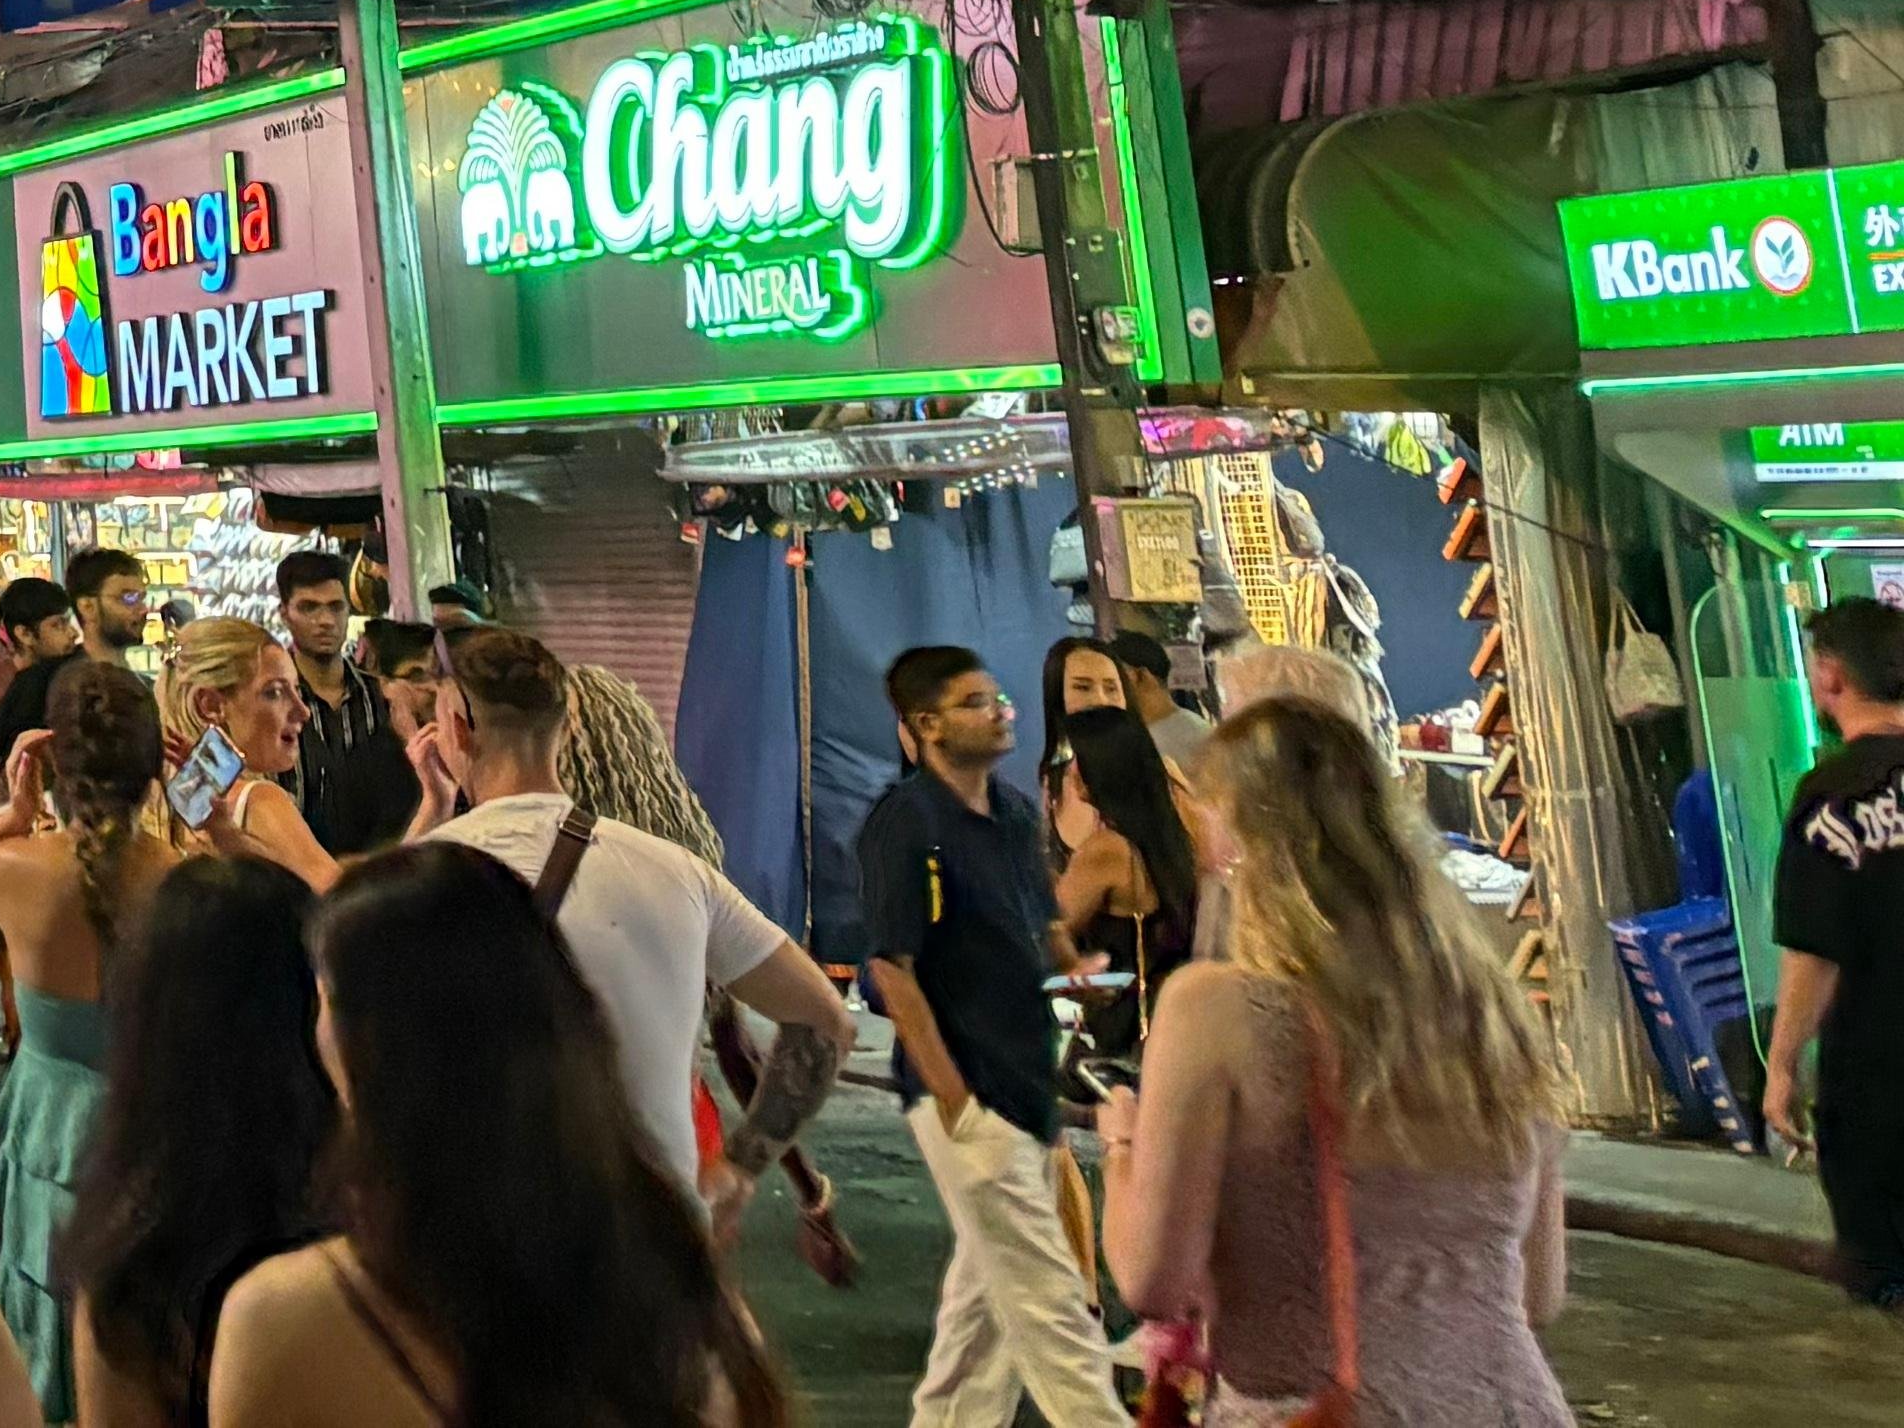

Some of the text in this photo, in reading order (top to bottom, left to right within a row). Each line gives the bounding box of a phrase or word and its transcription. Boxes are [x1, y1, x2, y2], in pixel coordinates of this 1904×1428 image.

[583, 52, 911, 259] Chang
[109, 151, 272, 292] Bangla
[1591, 225, 1752, 300] KBank
[118, 291, 328, 414] MARKET
[684, 259, 832, 329] MINERAL
